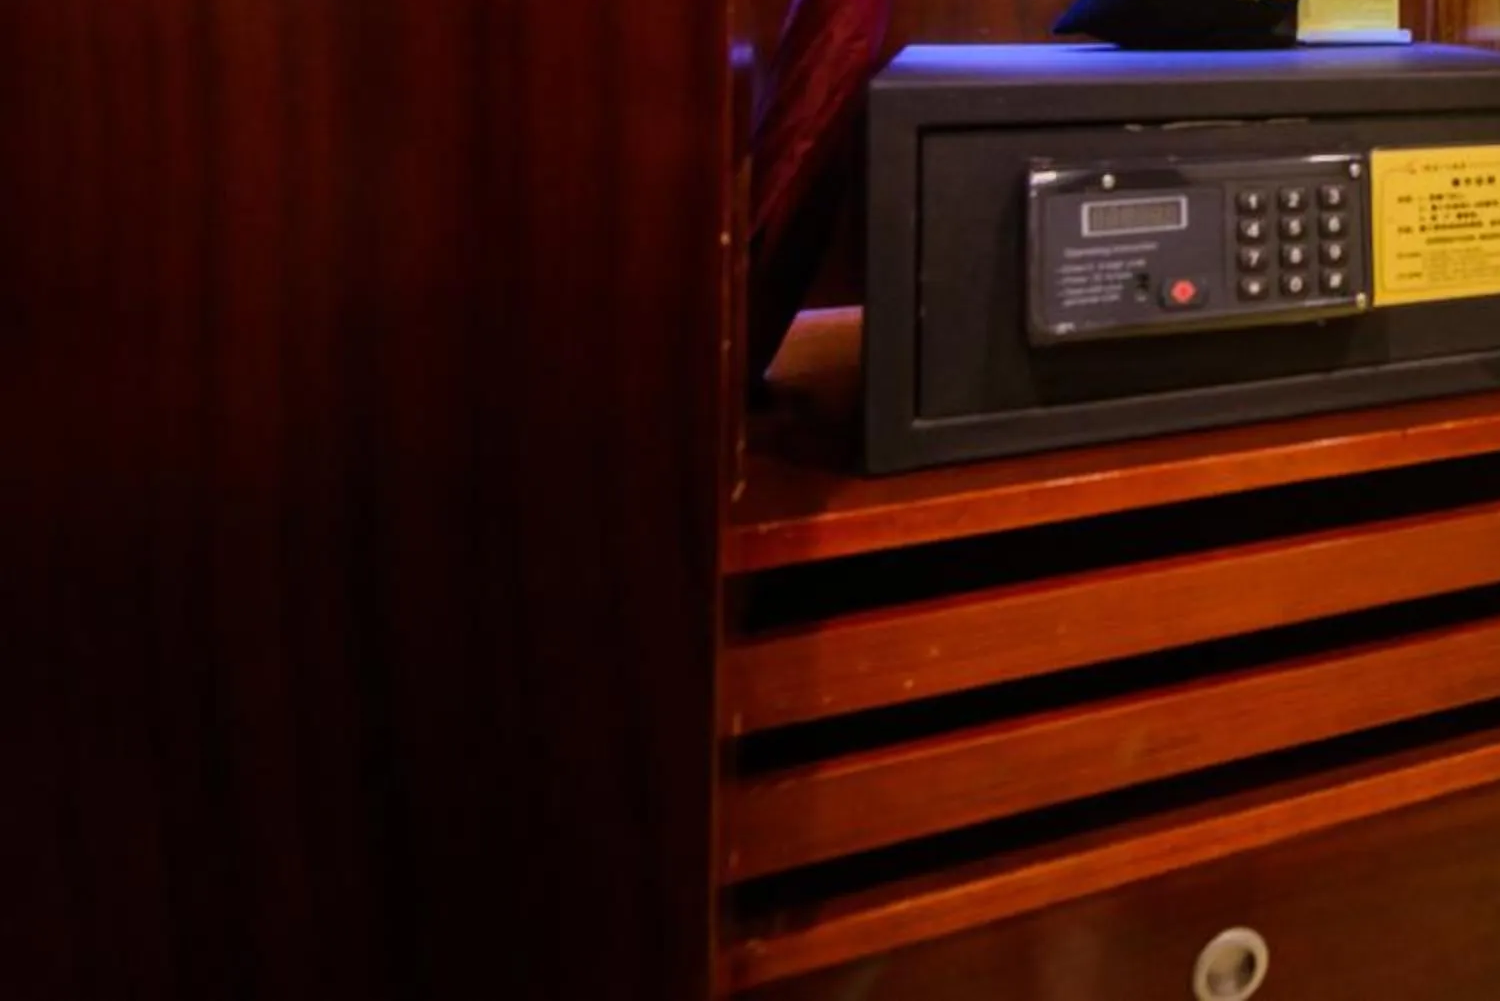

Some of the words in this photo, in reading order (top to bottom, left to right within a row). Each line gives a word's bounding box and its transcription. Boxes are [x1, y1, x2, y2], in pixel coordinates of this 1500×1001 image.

[1248, 193, 1258, 209] 1
[1287, 191, 1300, 208] 2
[1328, 187, 1340, 205] 3
[1246, 221, 1260, 238] 4
[1248, 249, 1260, 267] 7
[1289, 275, 1302, 293] 0
